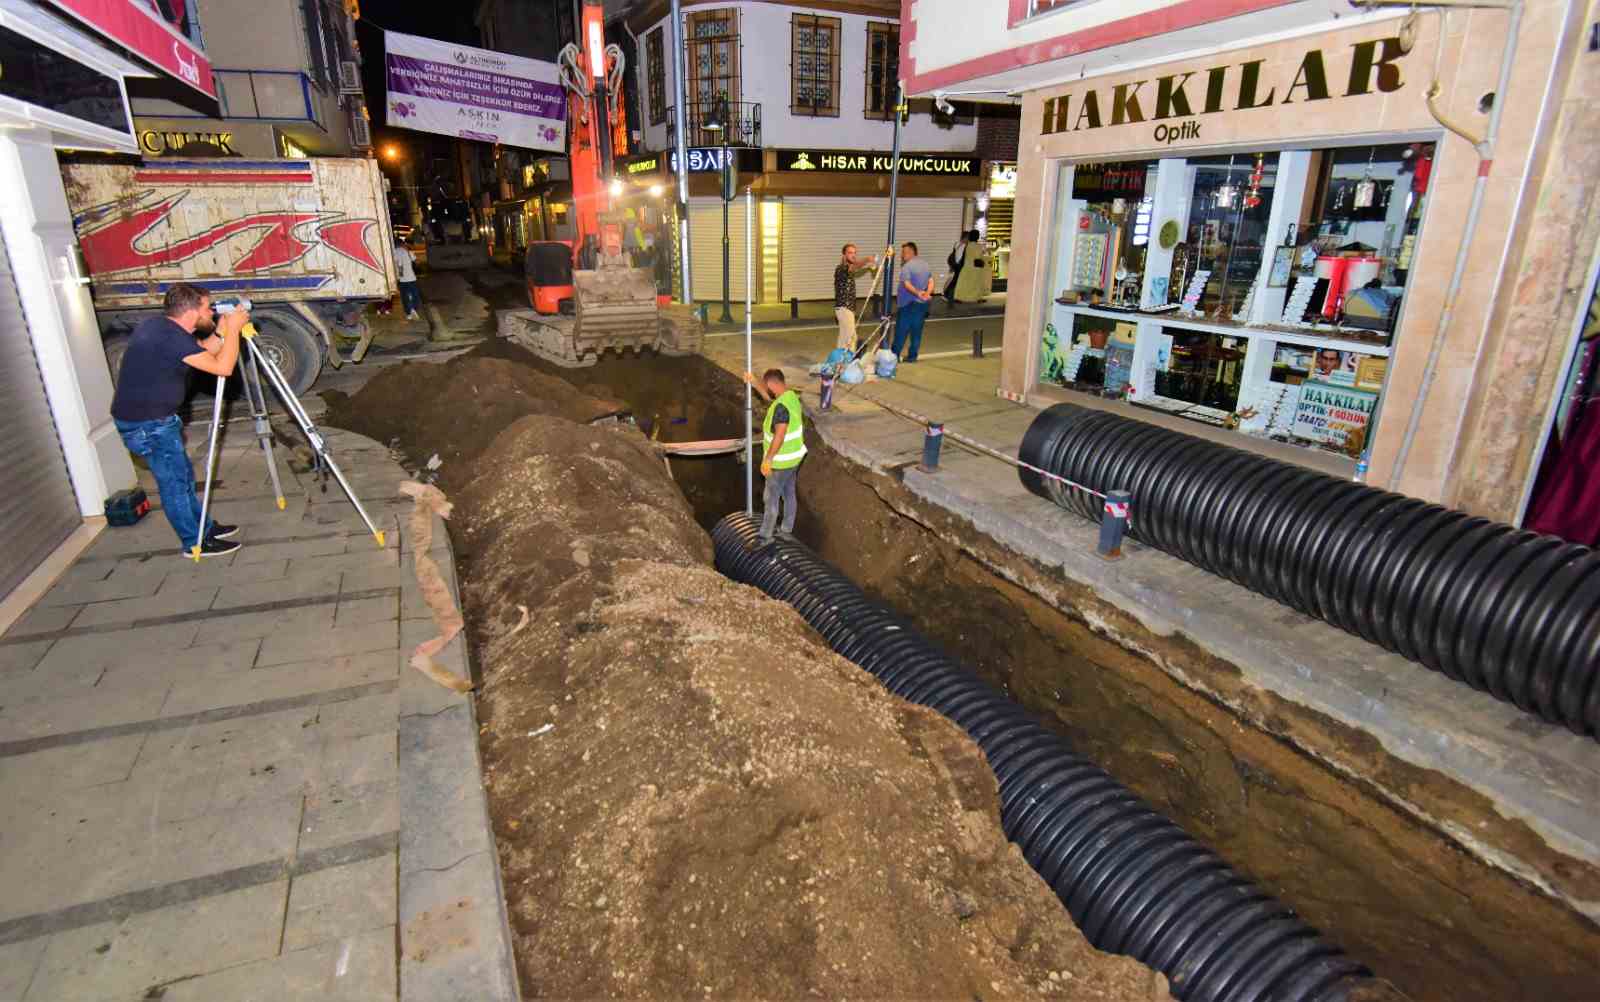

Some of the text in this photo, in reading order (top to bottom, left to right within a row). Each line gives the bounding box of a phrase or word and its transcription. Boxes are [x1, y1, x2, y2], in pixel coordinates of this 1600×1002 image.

[1039, 37, 1410, 136] HAKKILAR
[1153, 119, 1202, 145] Optik
[873, 156, 971, 173] KUYUMCULUK
